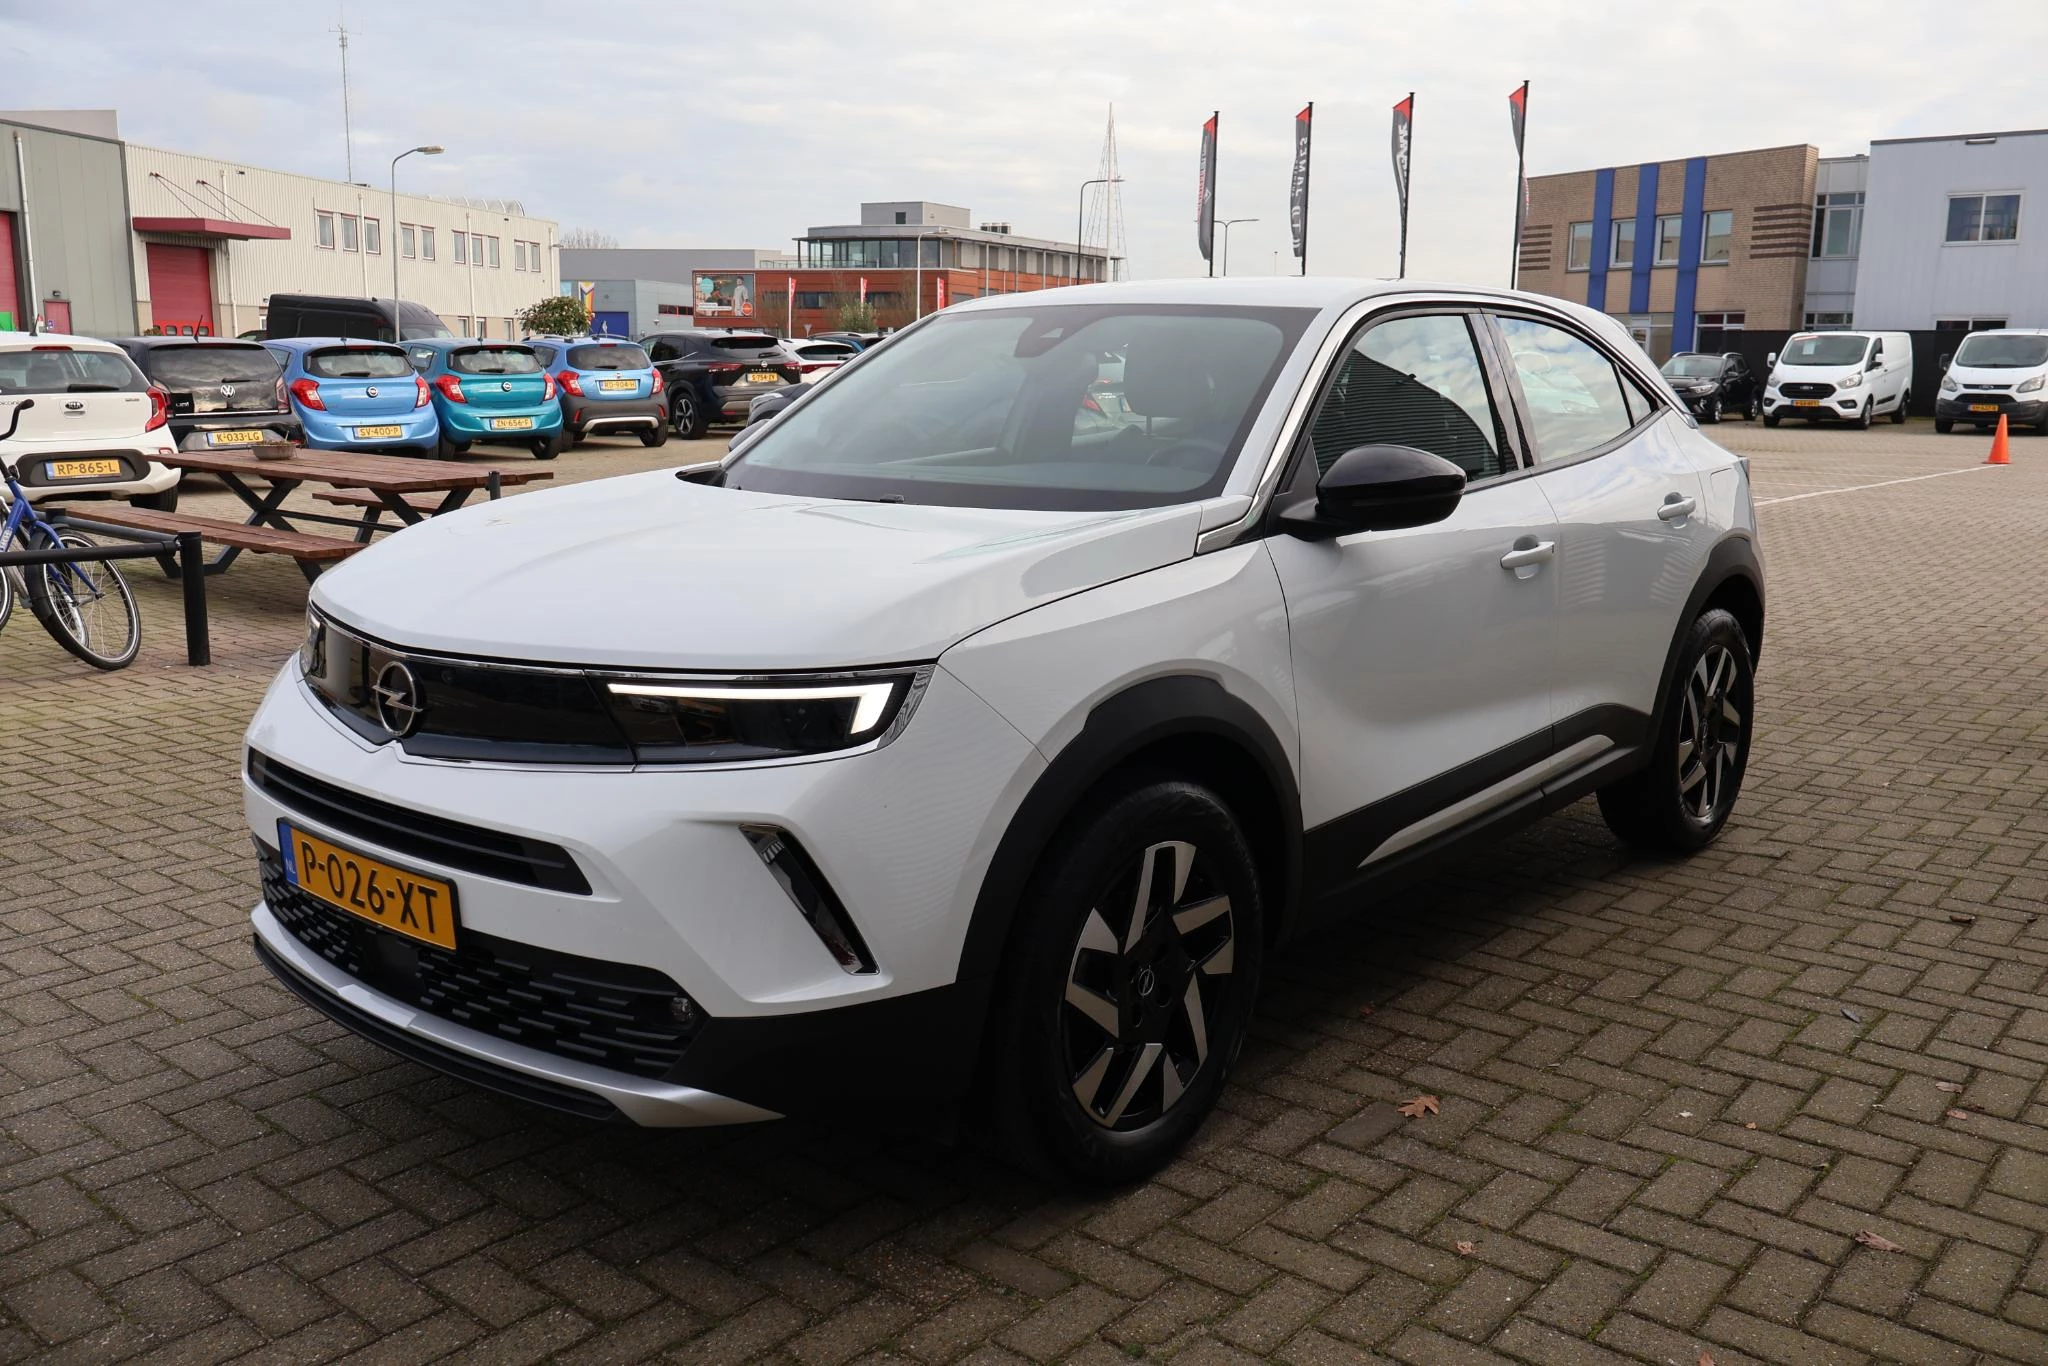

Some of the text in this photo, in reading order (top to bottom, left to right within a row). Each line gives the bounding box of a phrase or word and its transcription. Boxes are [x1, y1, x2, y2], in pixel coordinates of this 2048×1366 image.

[495, 419, 528, 428] ZN-656-F
[217, 432, 260, 443] K-033-LG
[360, 427, 398, 436] SV-400-P
[57, 462, 116, 475] RP-865-L
[285, 857, 296, 874] NL
[301, 840, 438, 933] P-026-XT
